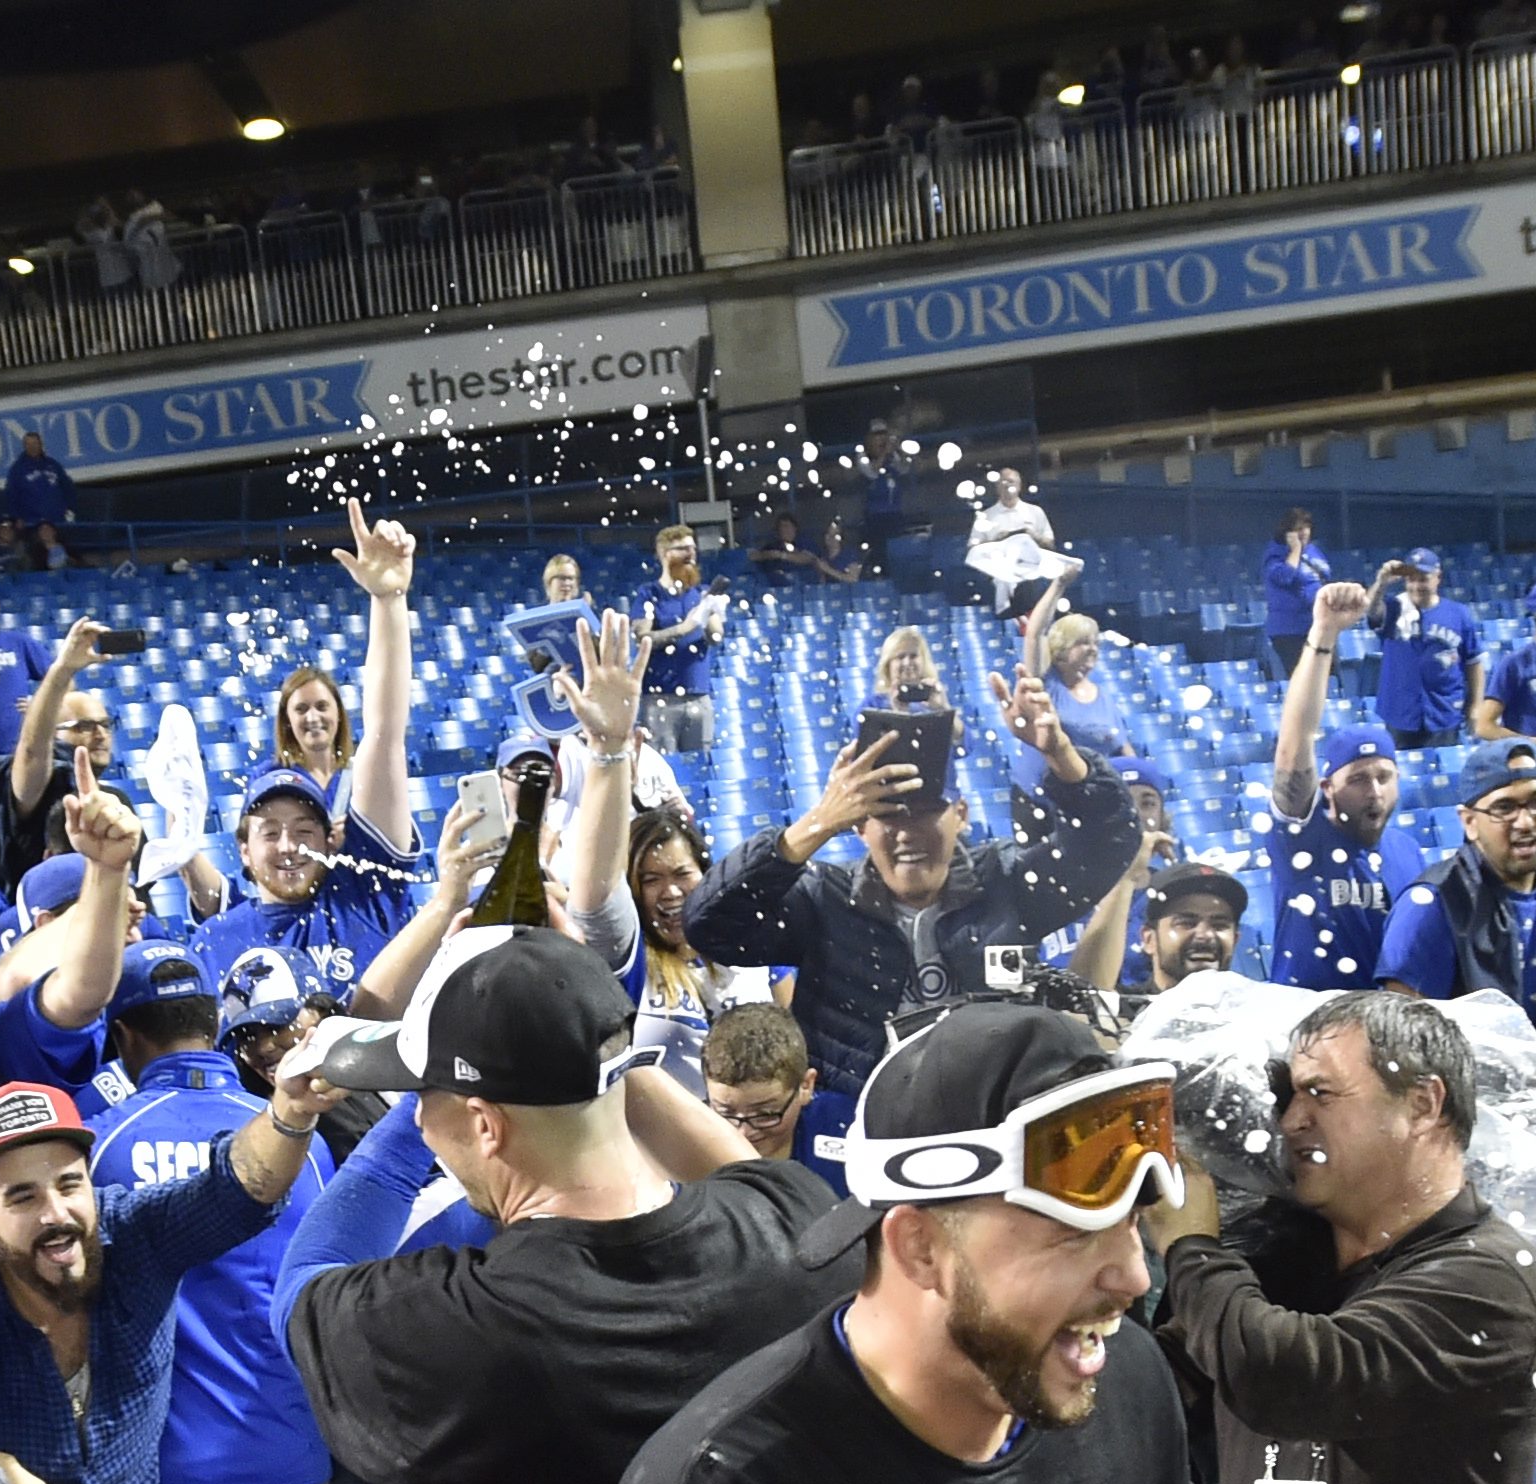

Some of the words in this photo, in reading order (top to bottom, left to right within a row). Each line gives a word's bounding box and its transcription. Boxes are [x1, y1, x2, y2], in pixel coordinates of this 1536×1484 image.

[867, 252, 1219, 349] TORONTO
[1243, 221, 1441, 298] STAR
[165, 376, 342, 445] STAR
[1330, 876, 1387, 910] BLUE
[306, 943, 356, 982] YS
[91, 1060, 138, 1107] BL
